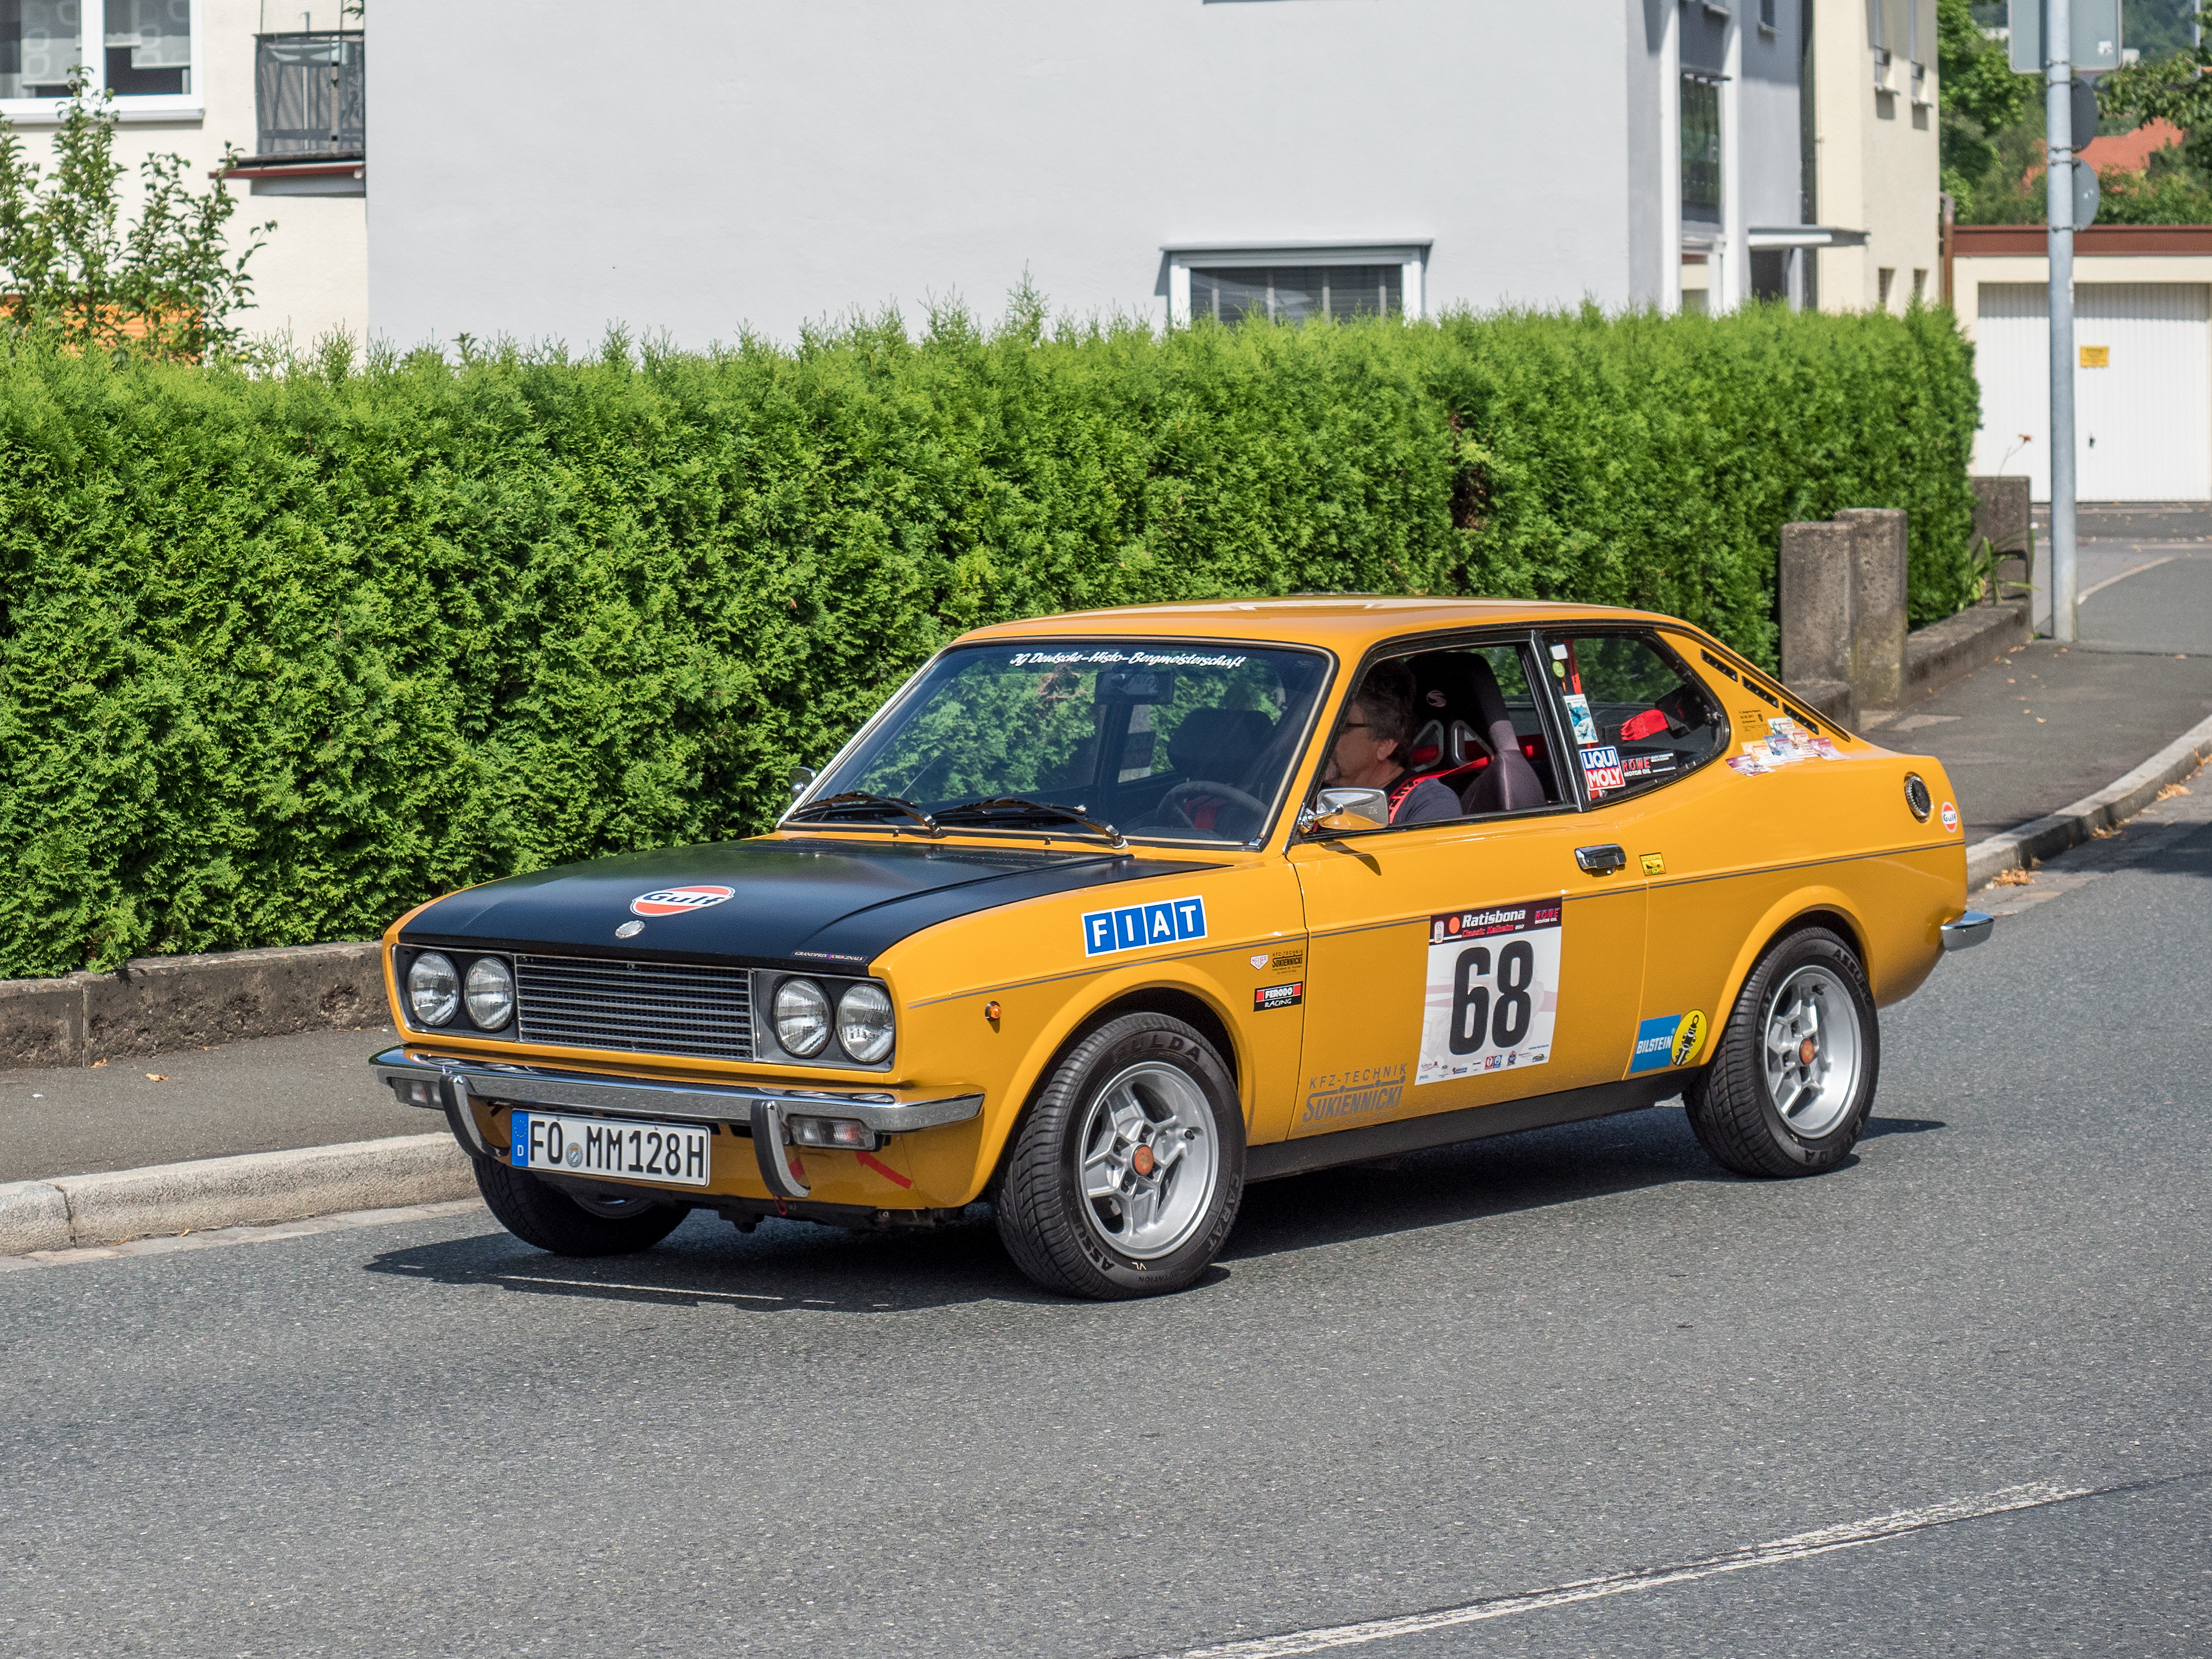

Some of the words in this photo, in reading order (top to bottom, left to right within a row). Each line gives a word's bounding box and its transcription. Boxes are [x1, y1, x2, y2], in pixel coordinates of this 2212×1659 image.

[1582, 749, 1617, 769] LIQUI
[1621, 756, 1651, 772] ROWE
[1587, 768, 1620, 788] MOLY
[1943, 813, 1956, 822] Gulf
[643, 892, 726, 905] Gulf
[1461, 909, 1526, 928] Ratisbona
[1535, 907, 1561, 920] ROWE
[1093, 905, 1197, 947] FIAT
[1265, 987, 1293, 999] FERODO
[1449, 939, 1534, 1056] 68
[1265, 998, 1292, 1008] RACING
[1111, 1034, 1201, 1064] FULDA
[1636, 1035, 1673, 1055] BILSTEIN
[1309, 1063, 1407, 1090] KFZ-TECHNIK
[517, 1144, 524, 1156] D
[529, 1120, 563, 1164] FO
